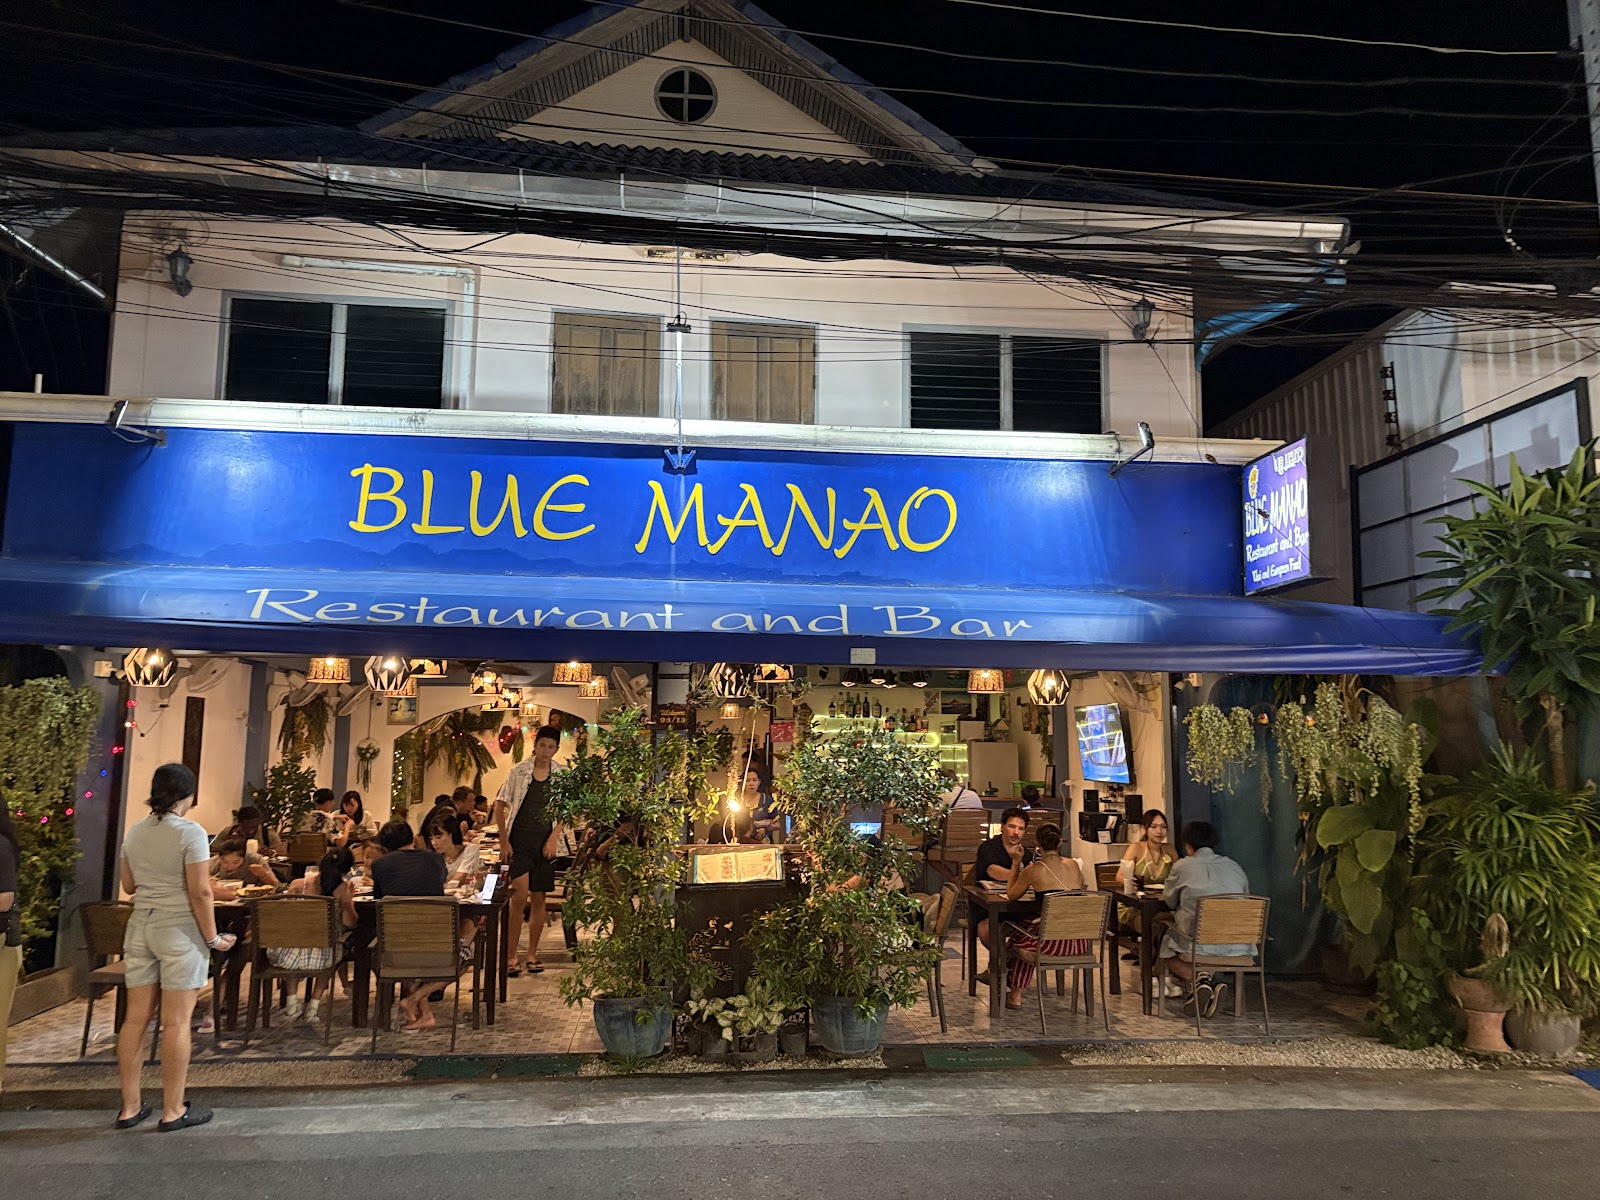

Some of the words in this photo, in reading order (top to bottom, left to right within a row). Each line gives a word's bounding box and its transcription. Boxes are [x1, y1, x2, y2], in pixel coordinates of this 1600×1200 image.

[348, 463, 596, 541] BLUE
[634, 480, 958, 559] MANAO
[1244, 494, 1269, 537] BLUE
[1269, 478, 1308, 535] MANAO
[1246, 542, 1279, 563] Restaurant
[1279, 529, 1293, 551] and
[1293, 526, 1309, 547] Bar
[245, 588, 685, 630] Restaurant
[711, 604, 850, 635] and
[872, 605, 1034, 638] Bar
